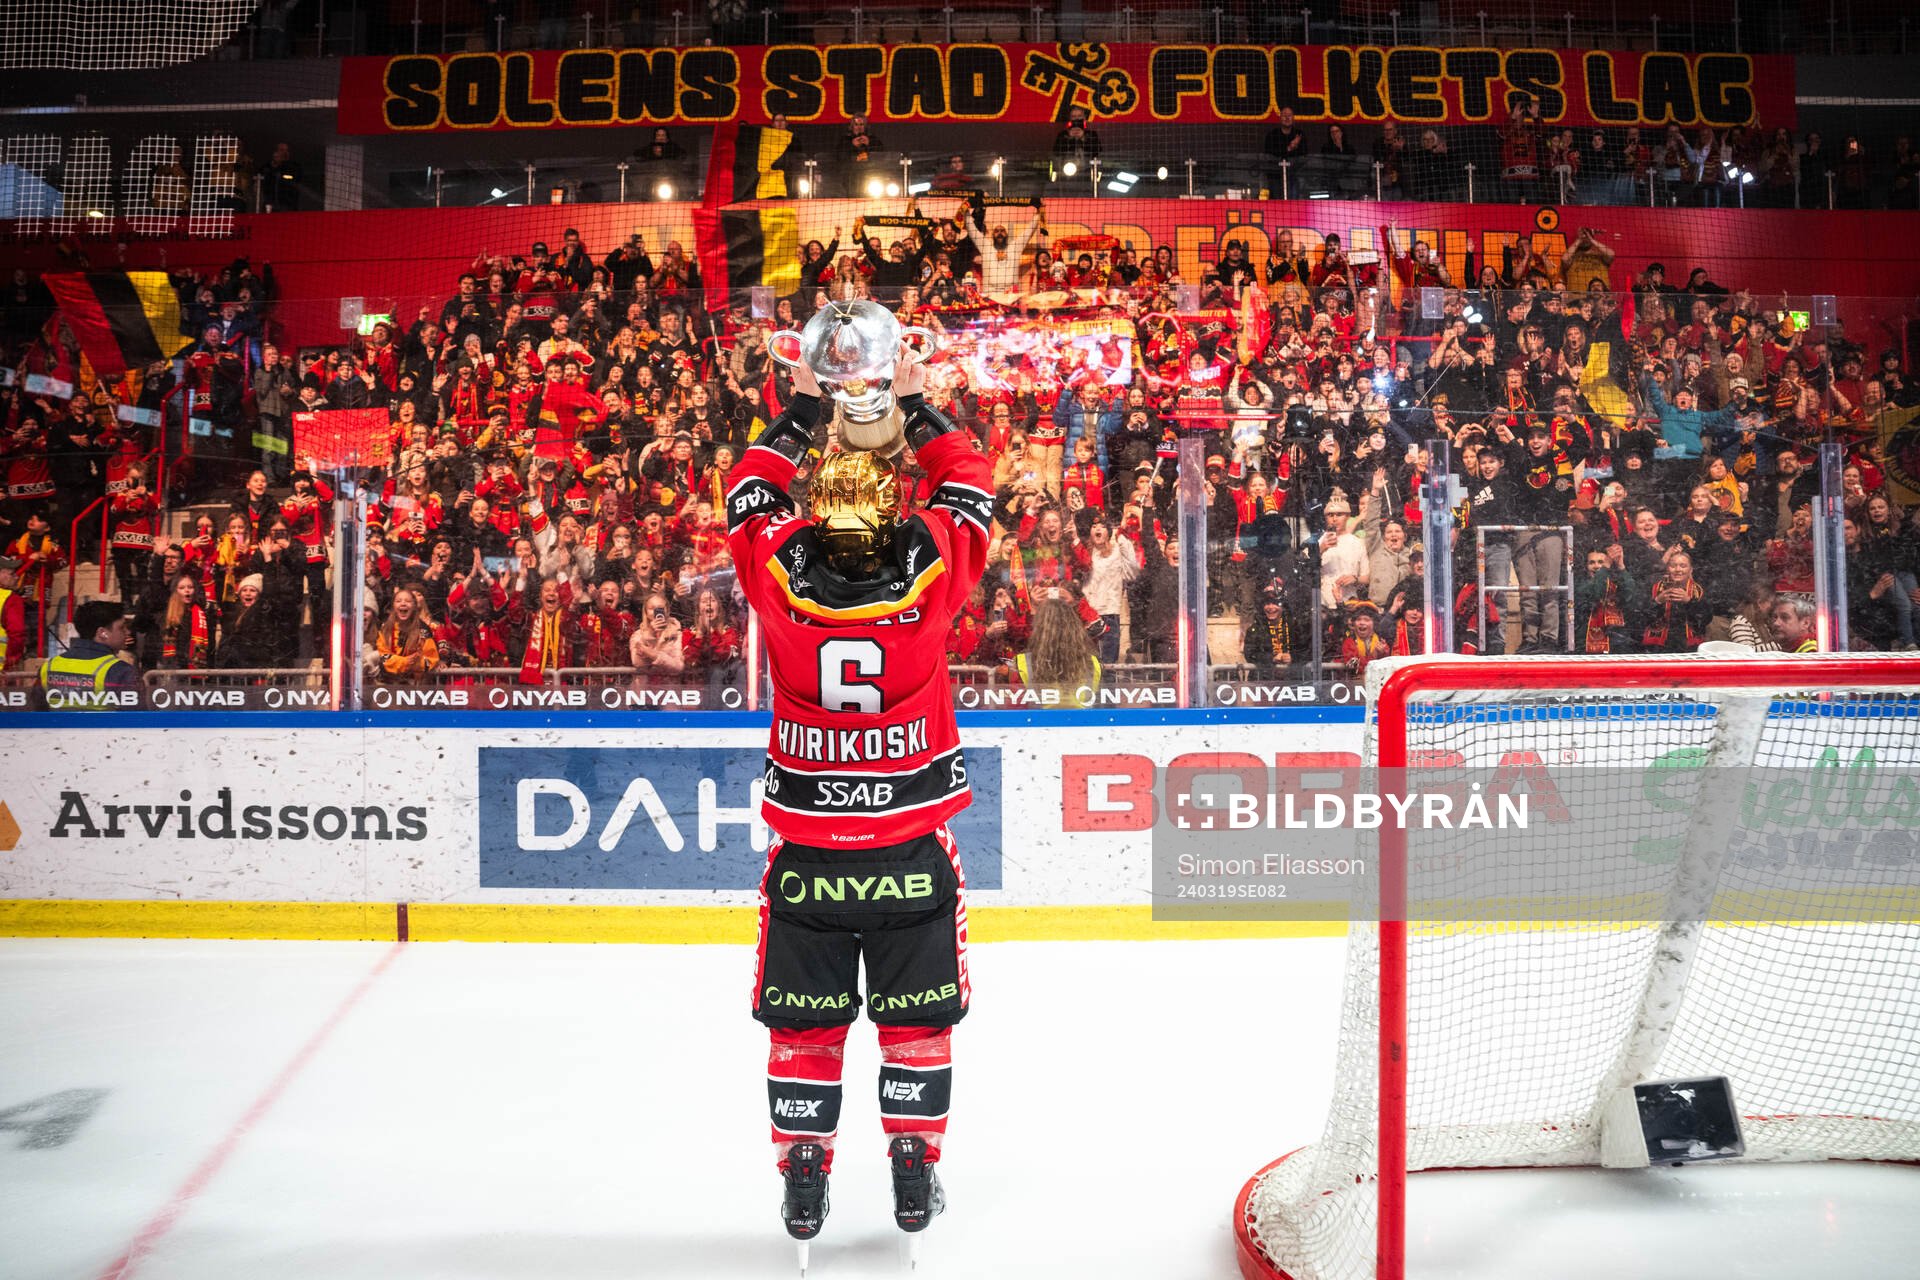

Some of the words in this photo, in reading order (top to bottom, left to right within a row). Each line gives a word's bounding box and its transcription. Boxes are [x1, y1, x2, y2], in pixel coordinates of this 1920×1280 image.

[382, 46, 741, 131] SOLENS
[761, 43, 1011, 122] STAD
[1148, 44, 1568, 124] FOLKETS
[1584, 50, 1755, 127] LAG
[817, 637, 886, 714] 6
[68, 691, 139, 706] NYAB
[175, 690, 245, 706] NYAB
[396, 690, 468, 706] NYAB
[513, 690, 587, 706] NYAB
[626, 690, 701, 707] NYAB
[985, 689, 1060, 706] NYAB
[1101, 688, 1176, 704] NYAB
[1241, 686, 1316, 703] NYAB
[778, 716, 929, 762] HIIRIKOSKI
[814, 781, 893, 807] SSAB
[50, 788, 428, 841] Arvidssons
[814, 873, 933, 901] NYAB
[785, 991, 850, 1009] NYAB
[887, 983, 958, 1010] NYAB
[882, 1079, 927, 1102] NEX
[774, 1098, 824, 1118] NEX
